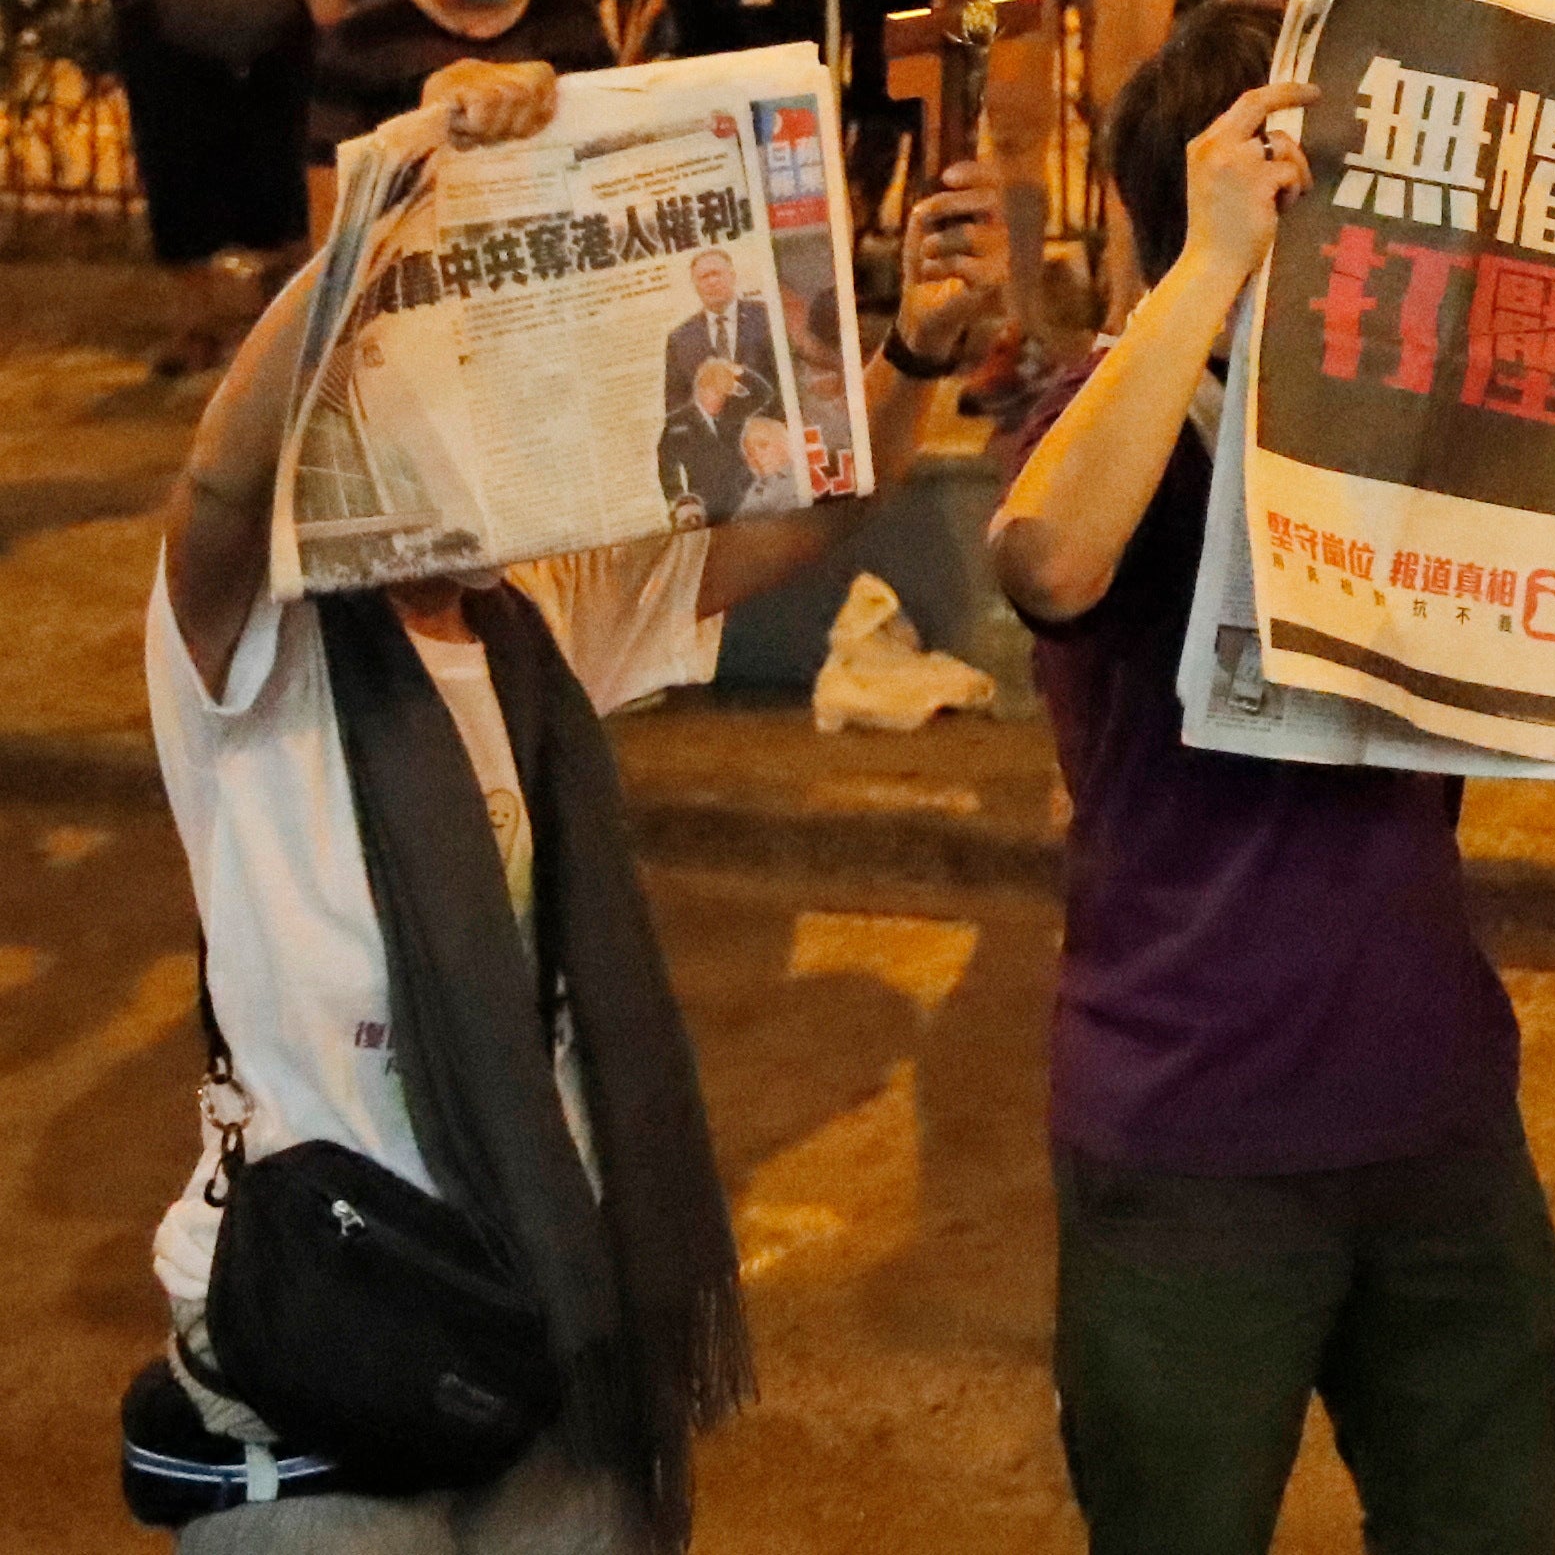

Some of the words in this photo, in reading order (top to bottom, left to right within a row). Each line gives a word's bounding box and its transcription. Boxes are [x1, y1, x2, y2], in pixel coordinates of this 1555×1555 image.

[1266, 510, 1377, 583] 堅守崗位
[1388, 549, 1519, 609] 報道真相
